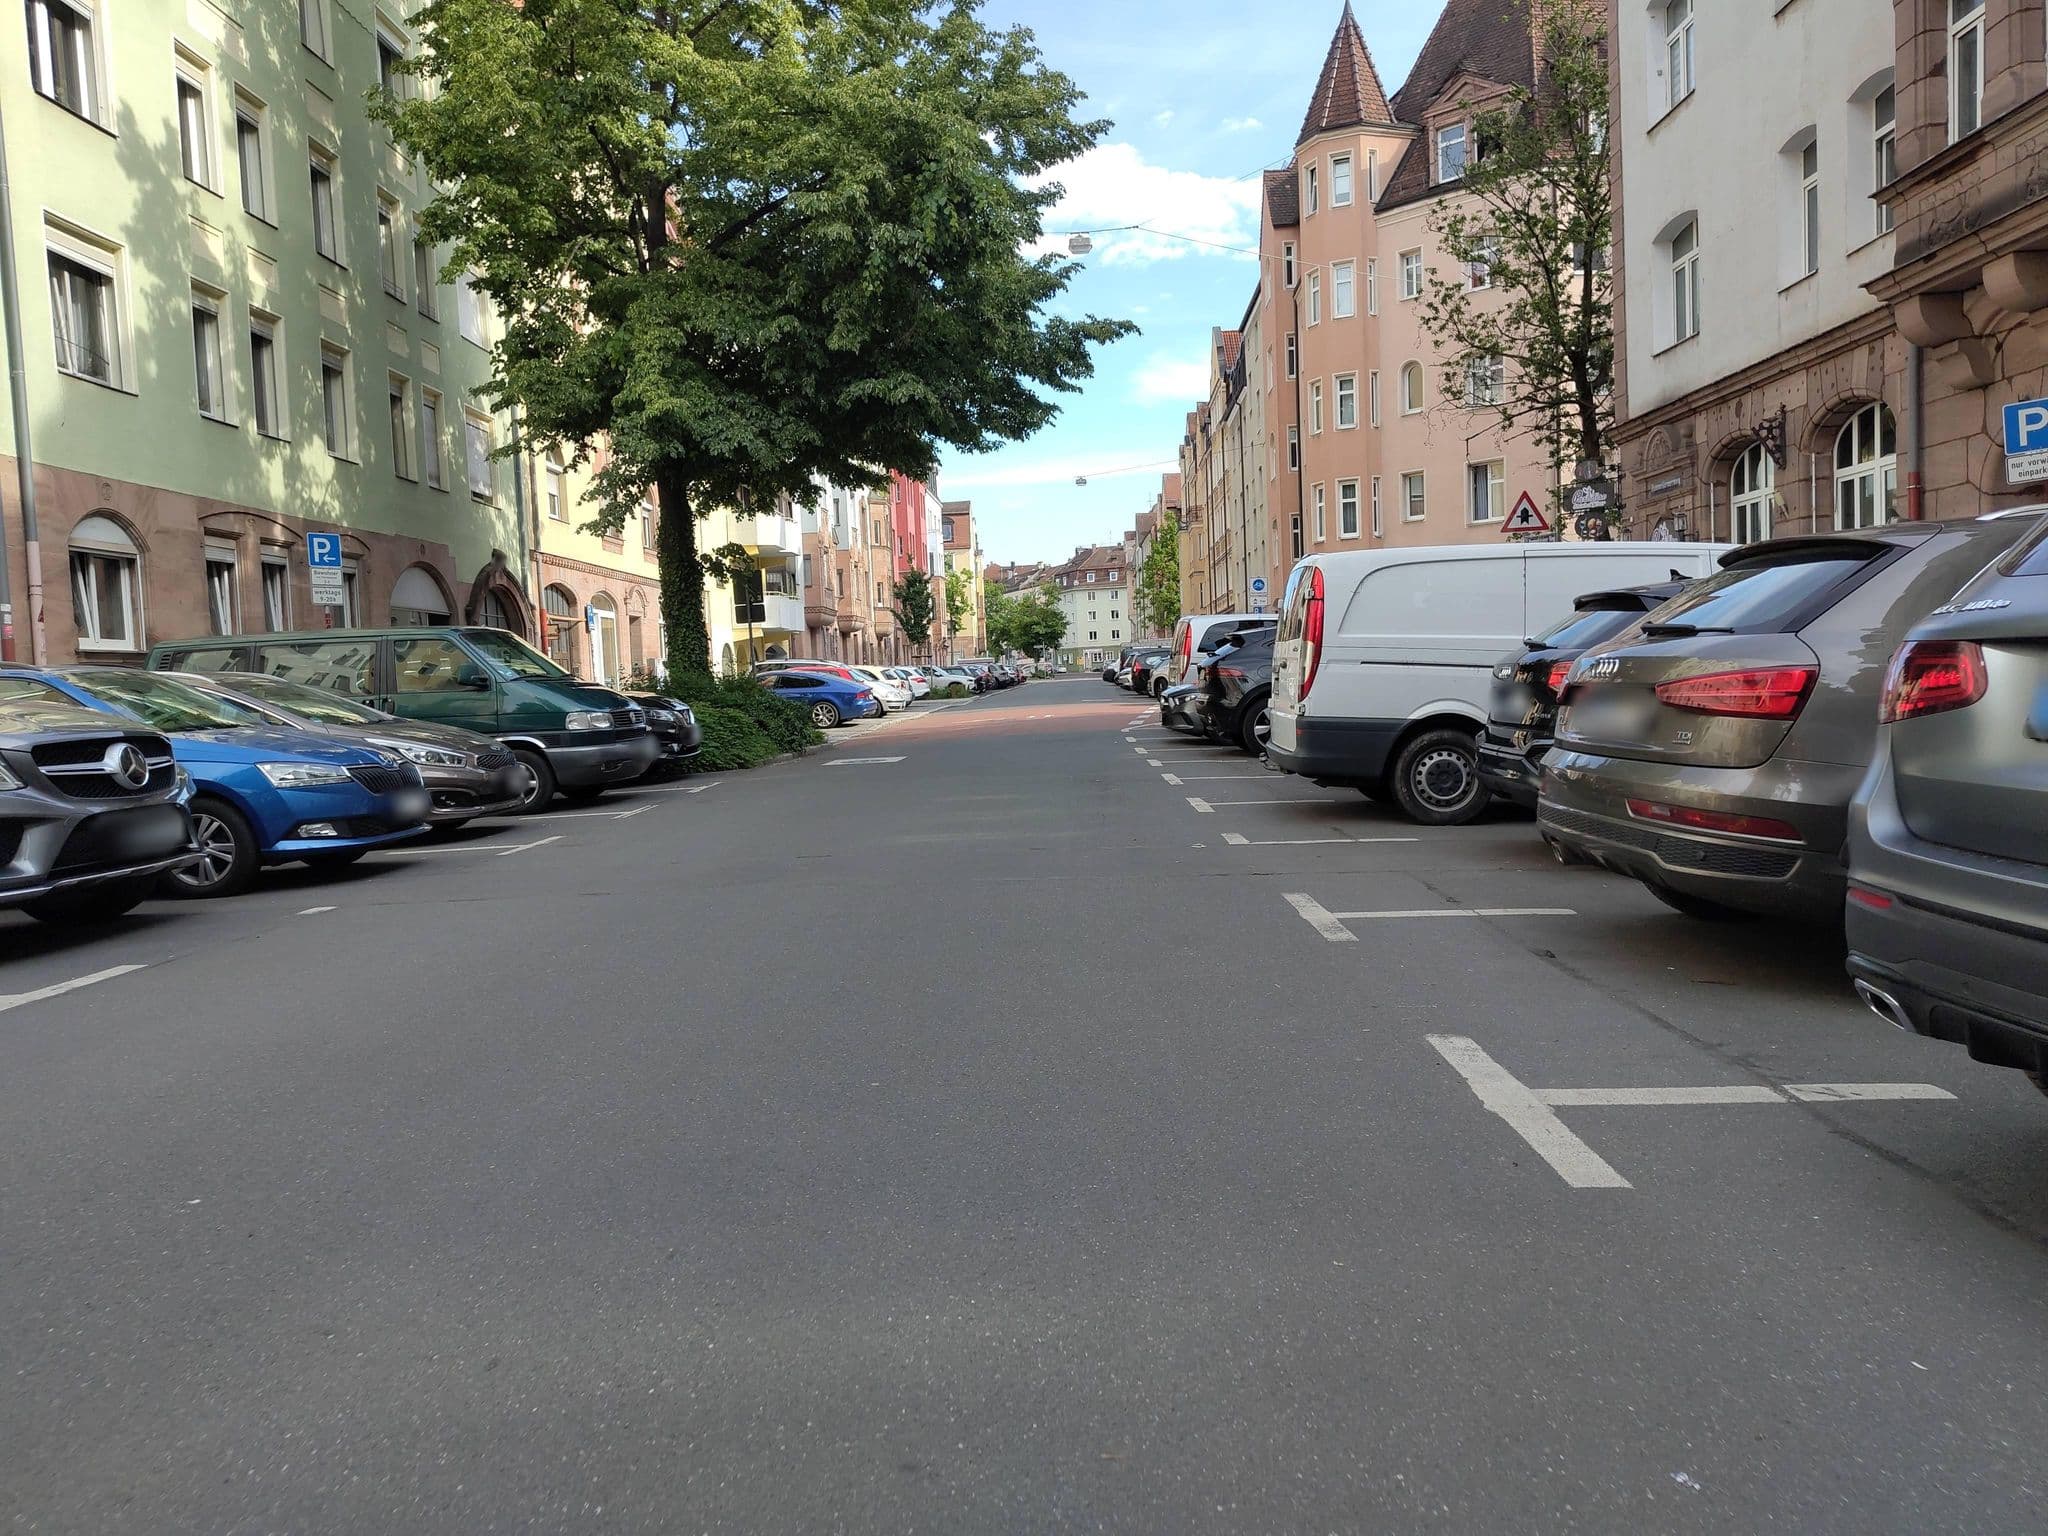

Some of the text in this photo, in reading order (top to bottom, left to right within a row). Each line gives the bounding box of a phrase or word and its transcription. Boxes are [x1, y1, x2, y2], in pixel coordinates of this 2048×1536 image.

[2018, 407, 2048, 447] P
[2011, 457, 2048, 470] nur vorw
[312, 537, 331, 562] P
[1676, 731, 1693, 740] TDI
